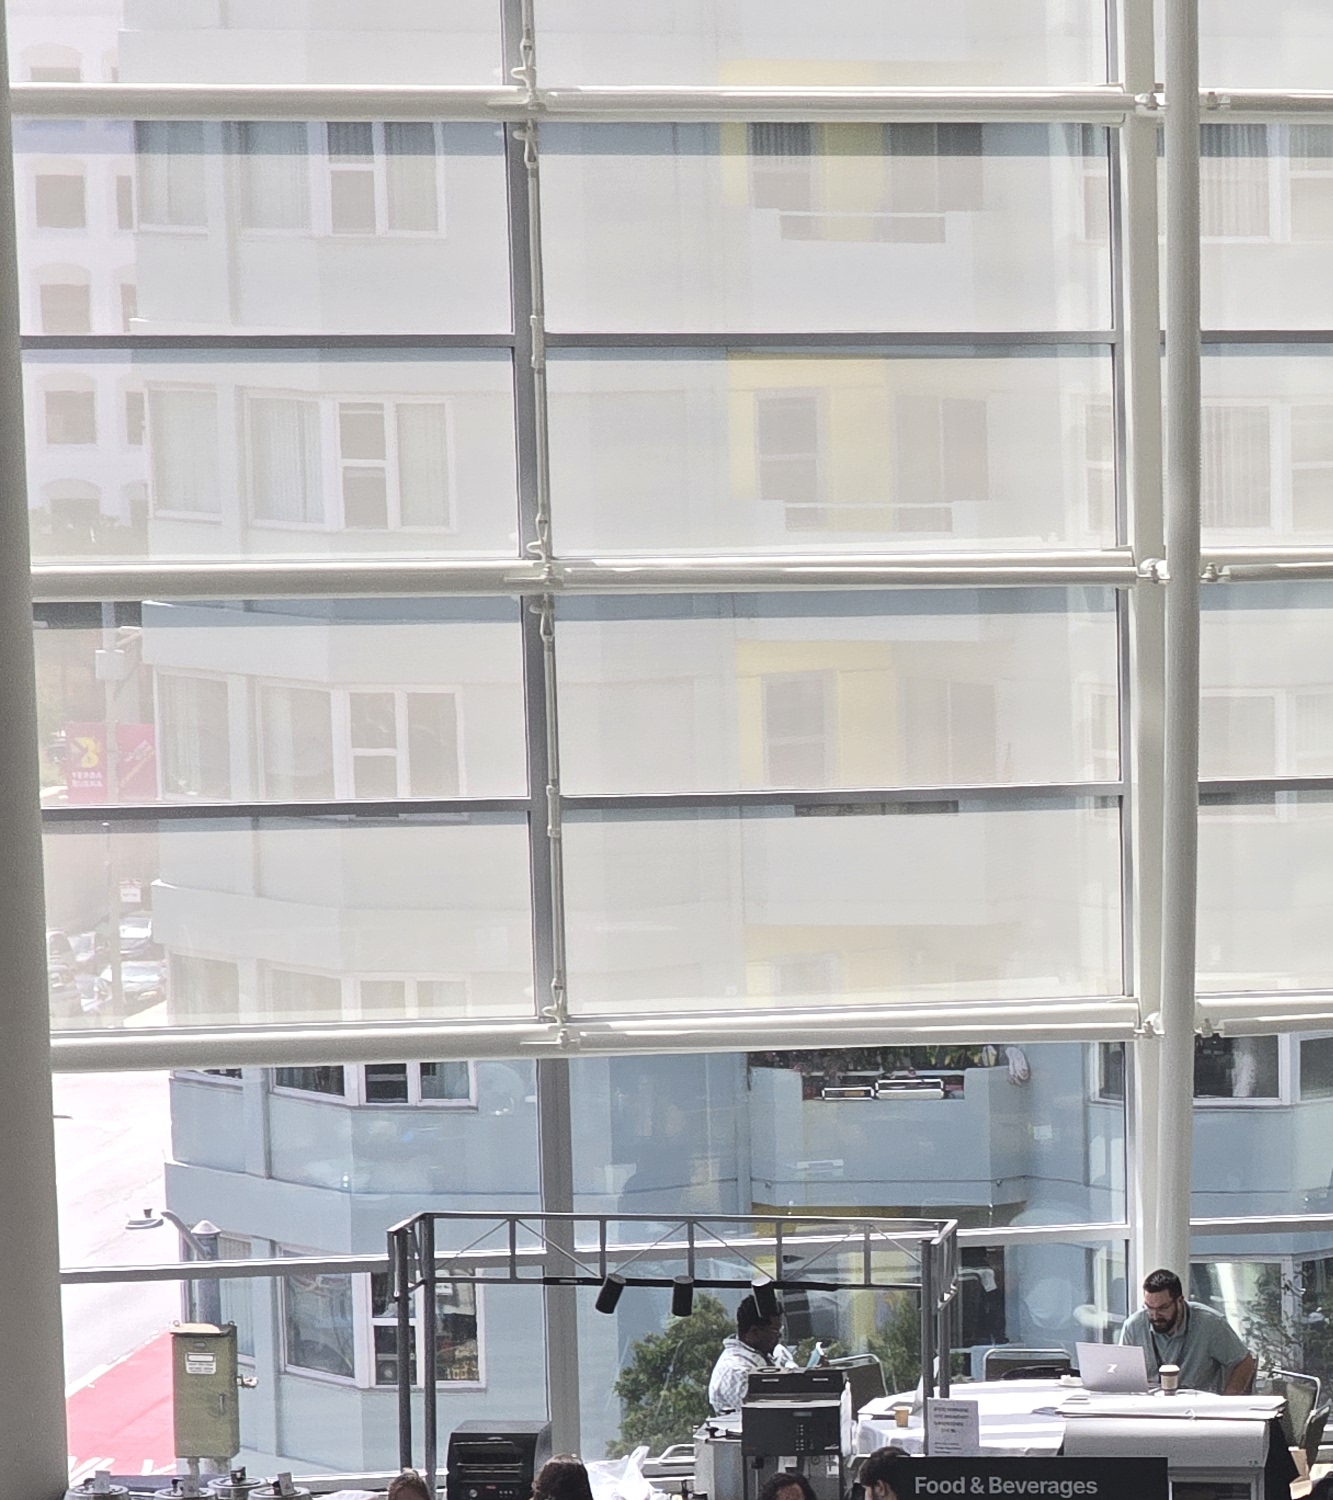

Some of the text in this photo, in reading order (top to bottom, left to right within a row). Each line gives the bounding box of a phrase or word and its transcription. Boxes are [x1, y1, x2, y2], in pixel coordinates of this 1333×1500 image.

[915, 1477, 1097, 1498] Food & Beverages
